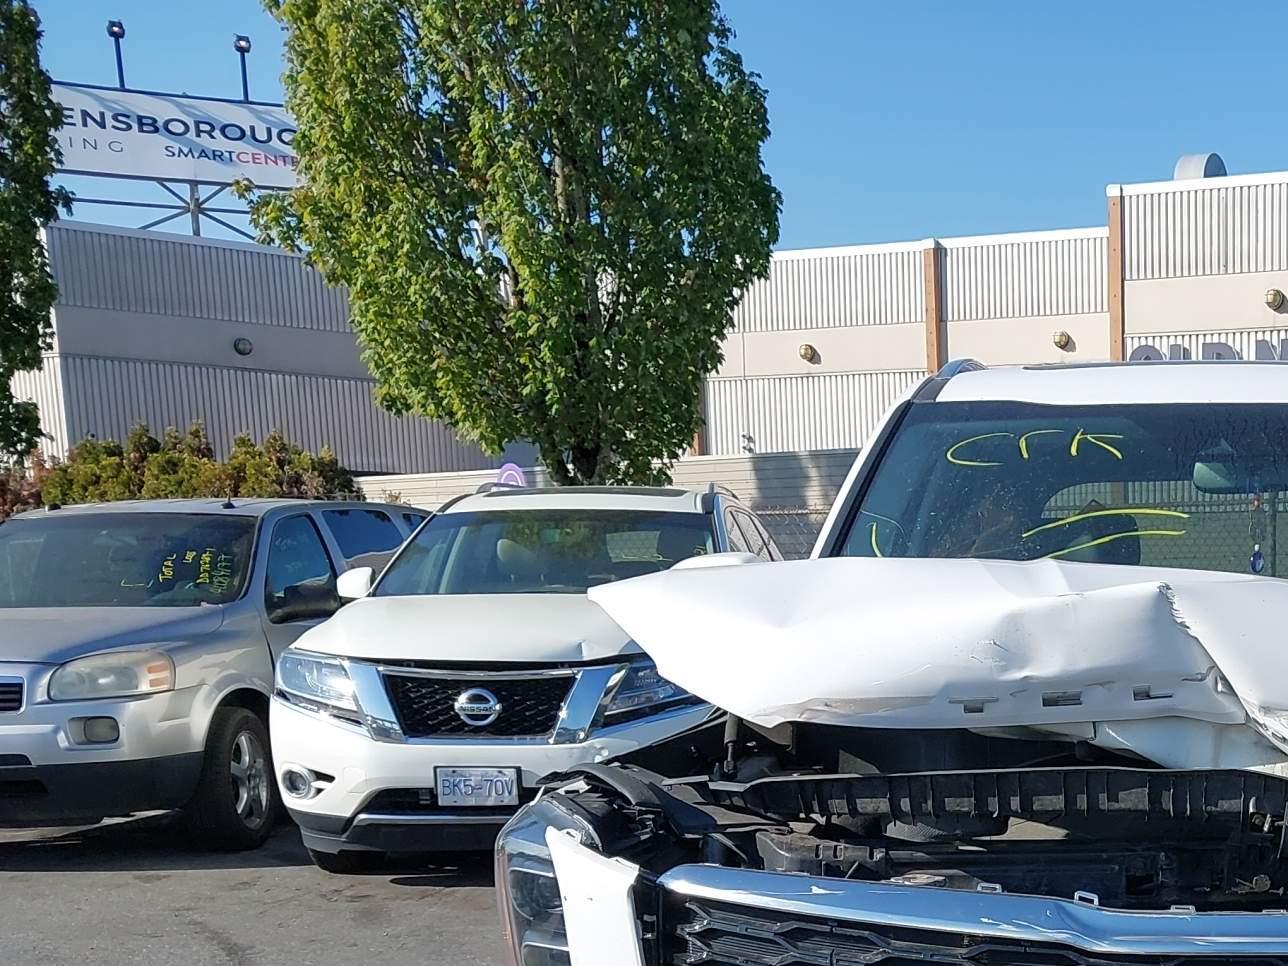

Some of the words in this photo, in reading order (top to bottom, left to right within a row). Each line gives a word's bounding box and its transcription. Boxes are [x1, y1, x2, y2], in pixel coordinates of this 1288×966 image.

[63, 107, 297, 146] ENSBOROUG
[68, 136, 124, 154] ING
[459, 703, 497, 713] NISSAN
